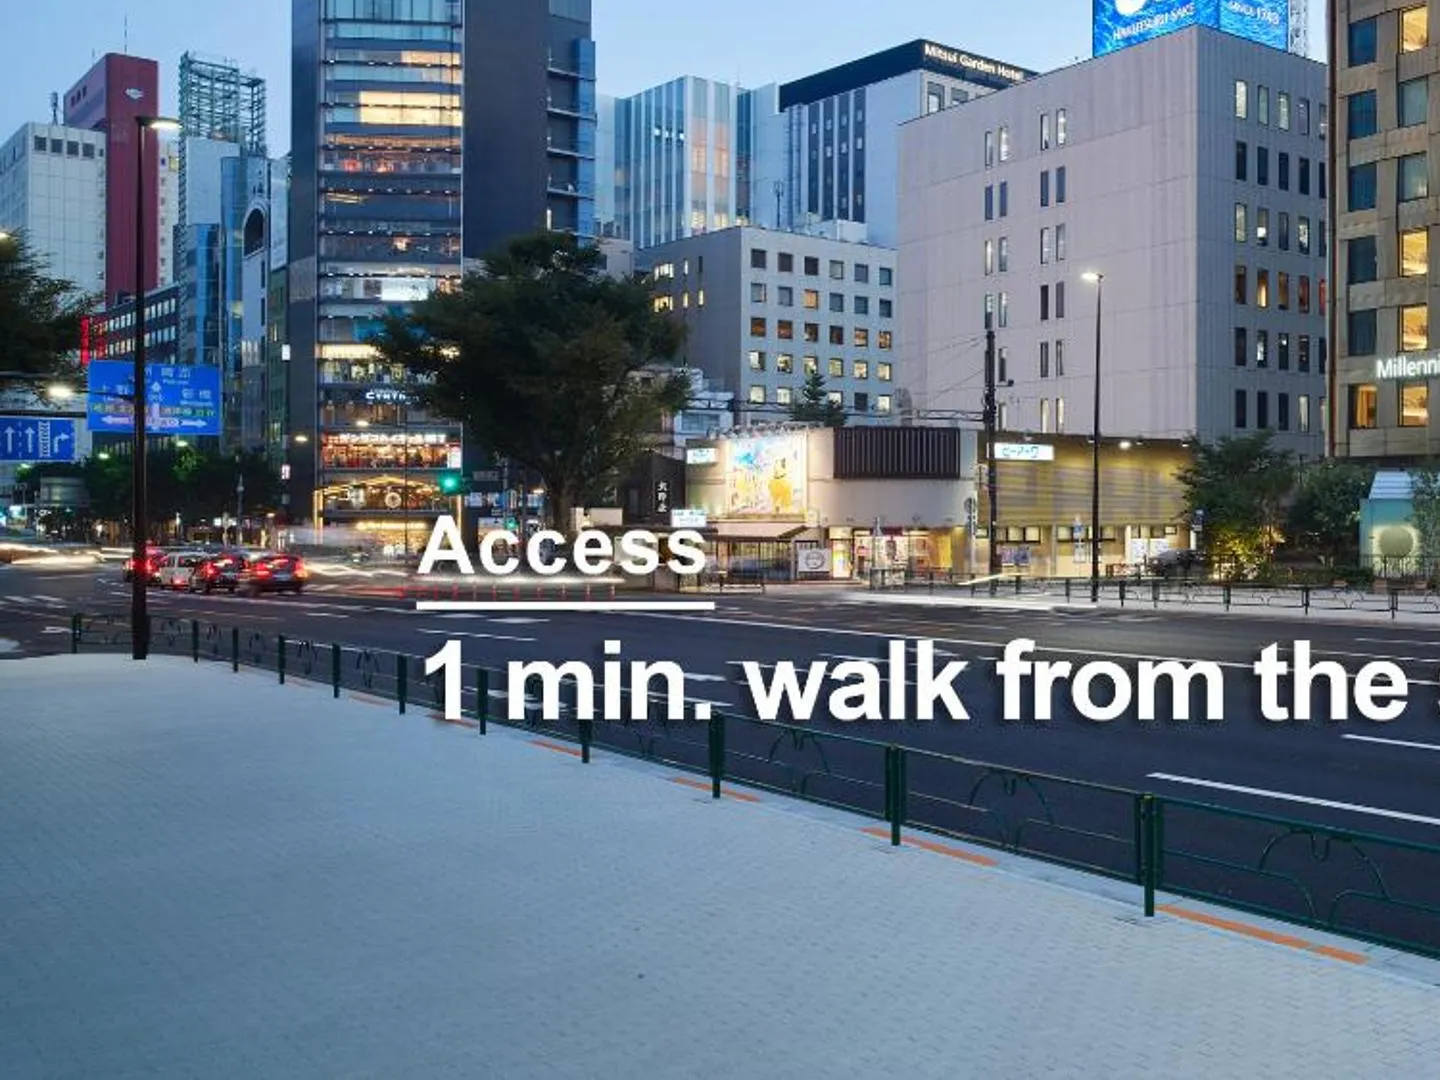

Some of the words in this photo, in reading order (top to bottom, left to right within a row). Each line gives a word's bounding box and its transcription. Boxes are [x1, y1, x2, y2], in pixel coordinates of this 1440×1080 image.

[925, 43, 957, 63] Mitsui
[960, 55, 995, 74] Garden
[998, 65, 1024, 81] Hotel
